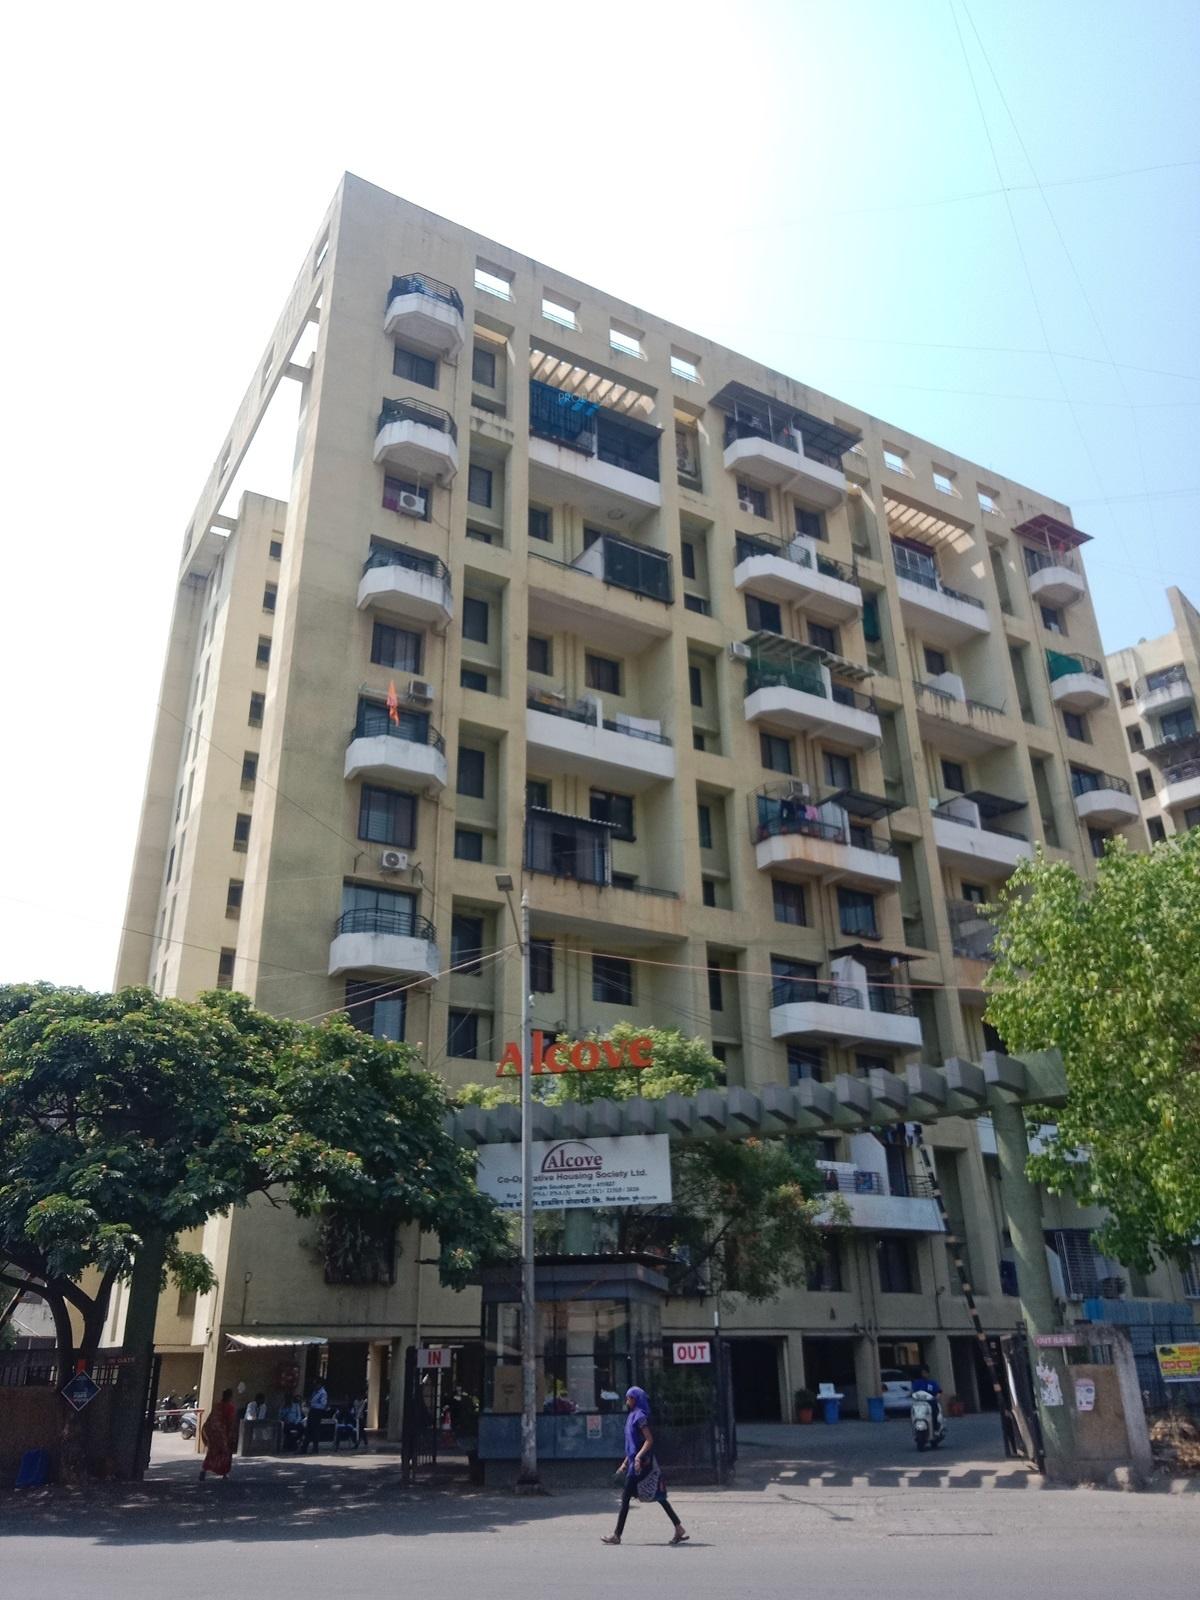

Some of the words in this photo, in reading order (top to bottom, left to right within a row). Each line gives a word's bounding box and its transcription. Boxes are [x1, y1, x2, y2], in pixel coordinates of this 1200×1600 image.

[496, 1030, 653, 1076] Alcove
[547, 1150, 603, 1168] Alcove
[497, 1173, 554, 1184] Co-Opative
[557, 1171, 593, 1181] Housing
[595, 1169, 628, 1179] Society
[630, 1168, 648, 1177] Ltd.
[428, 1351, 441, 1365] IN
[677, 1344, 706, 1360] OUT
